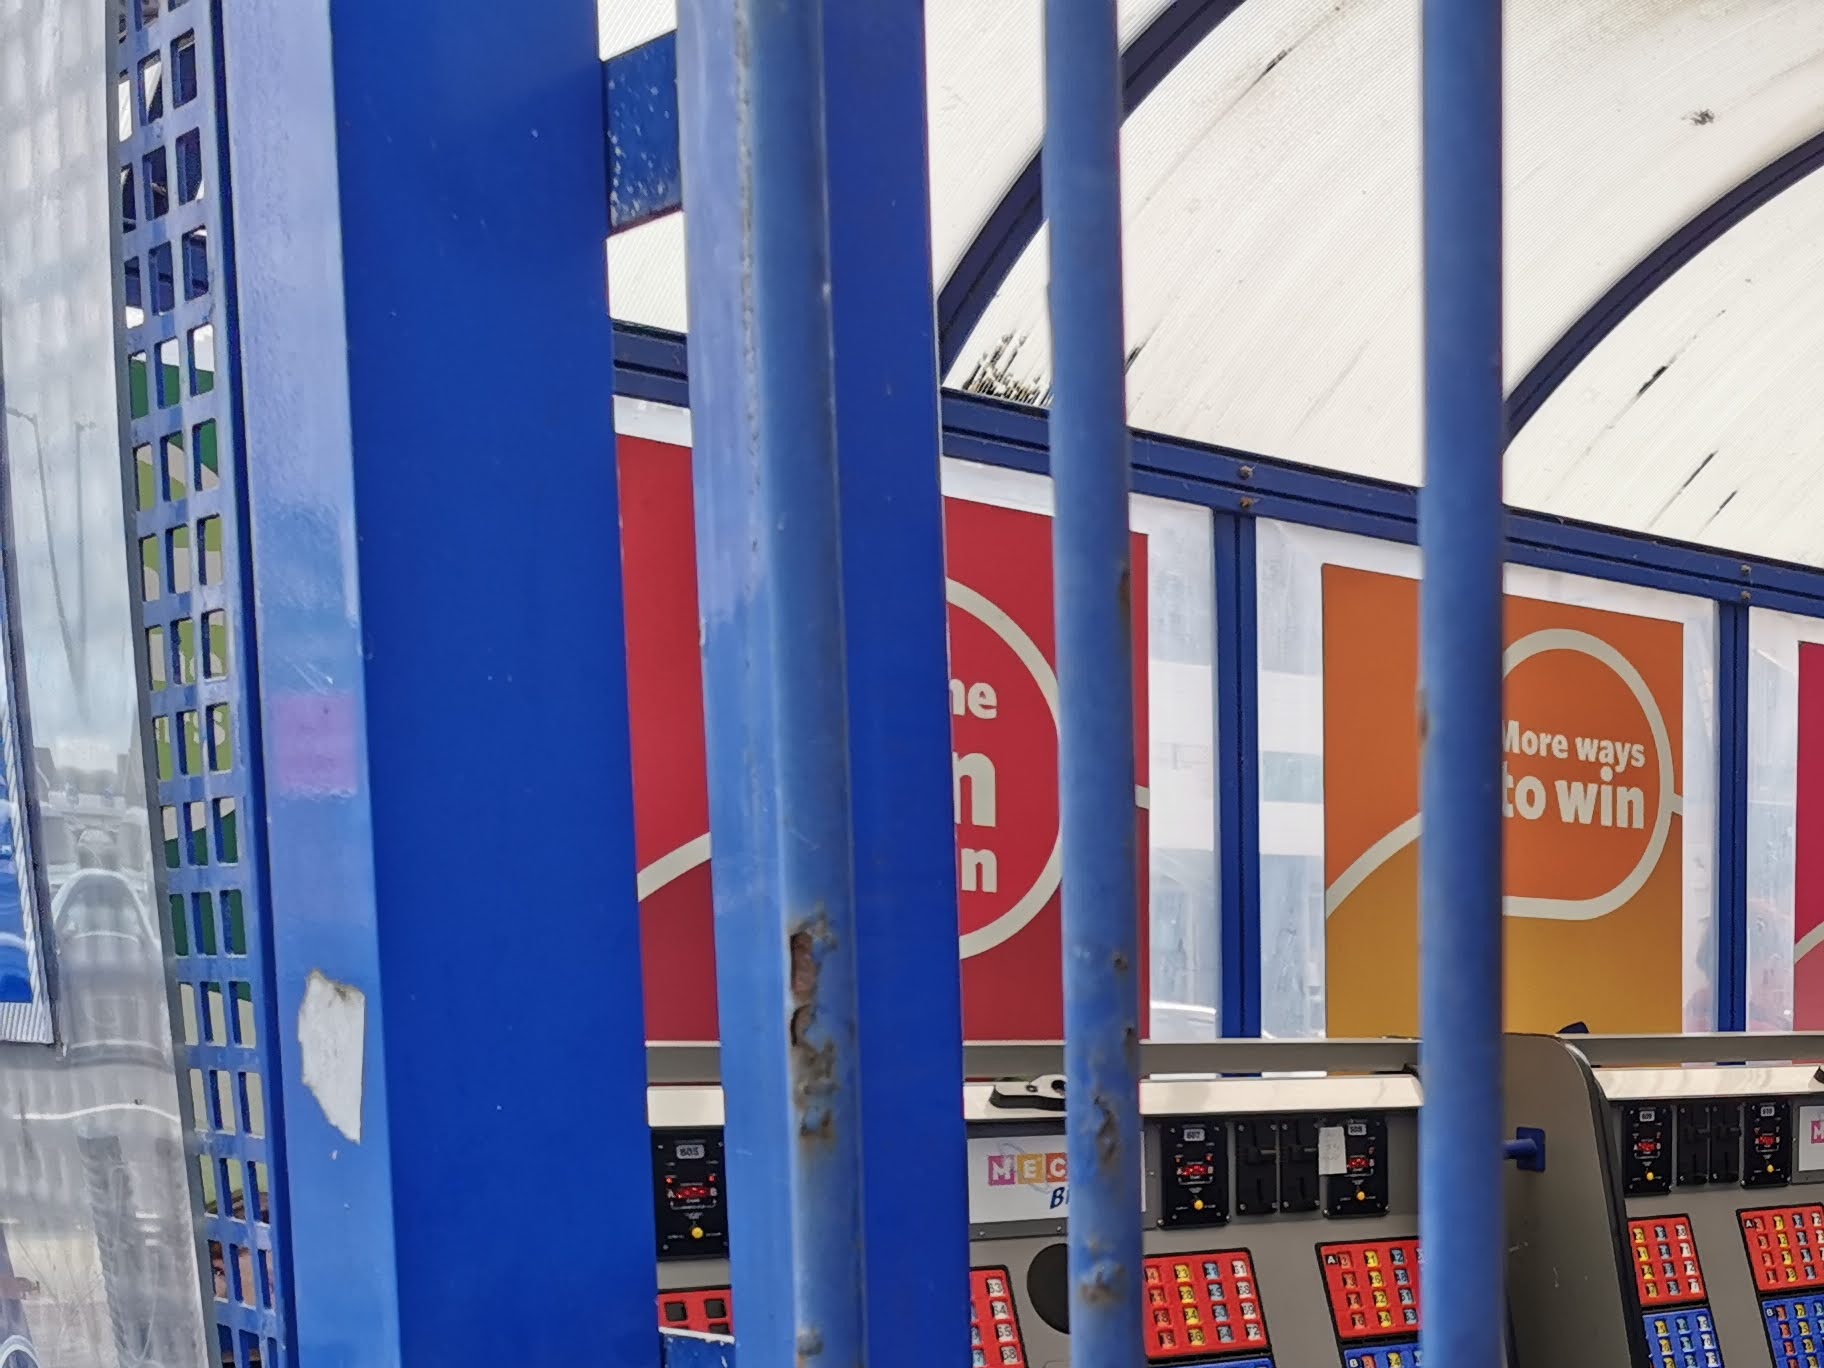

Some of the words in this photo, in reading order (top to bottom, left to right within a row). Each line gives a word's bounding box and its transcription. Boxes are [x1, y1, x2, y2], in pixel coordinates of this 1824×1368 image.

[1502, 719, 1569, 759] More
[1575, 736, 1646, 773] ways
[1502, 761, 1546, 820] to
[1554, 765, 1645, 829] win
[990, 1155, 1067, 1182] MEC
